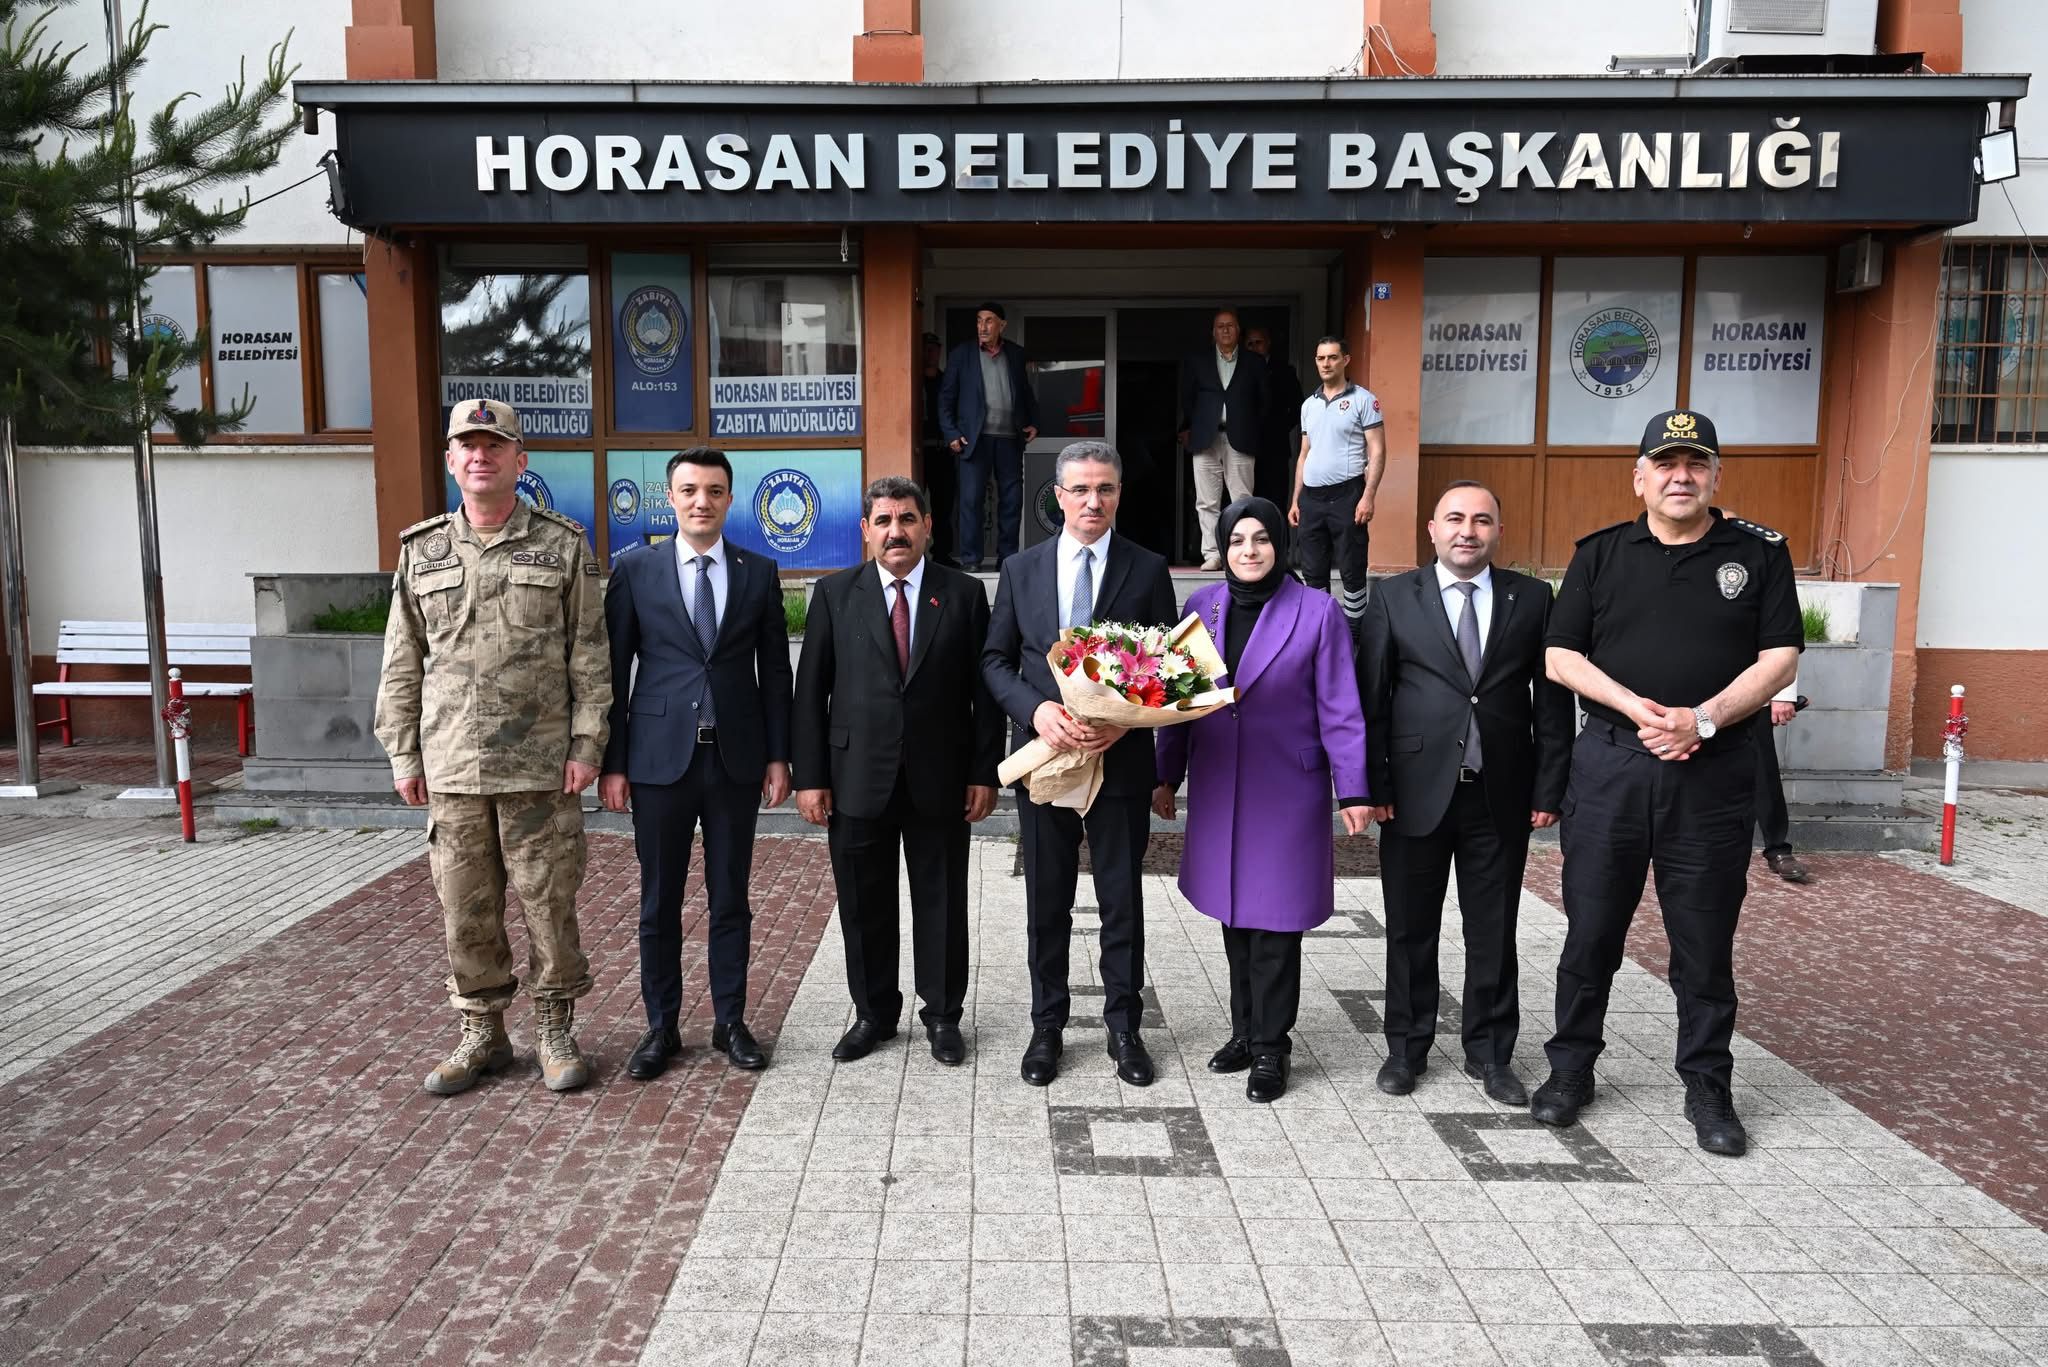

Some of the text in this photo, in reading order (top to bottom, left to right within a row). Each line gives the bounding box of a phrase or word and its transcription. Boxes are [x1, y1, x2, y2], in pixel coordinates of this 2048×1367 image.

[475, 117, 1841, 204] HORASAN BELEDİYE BAŞKANLIĞI
[221, 331, 293, 345] HORASAN
[1428, 322, 1523, 342] HORASAN
[1573, 311, 1657, 359] HORASAN BELEDİYESİ
[1711, 321, 1807, 341] HORASAN
[218, 345, 299, 362] BELEDİYESİ
[1422, 348, 1528, 372] BELEDİYESİ
[1703, 347, 1812, 372] BELEDİYESİ
[447, 380, 589, 405] HORASAN BELEDİYESİ
[631, 381, 678, 392] ALO:153
[714, 376, 856, 403] HORASAN BELEDİYESİ
[1595, 383, 1635, 396] 1952
[716, 407, 856, 434] ZABITA MÜDÜRLÜĞÜ
[768, 473, 805, 488] ZABITA
